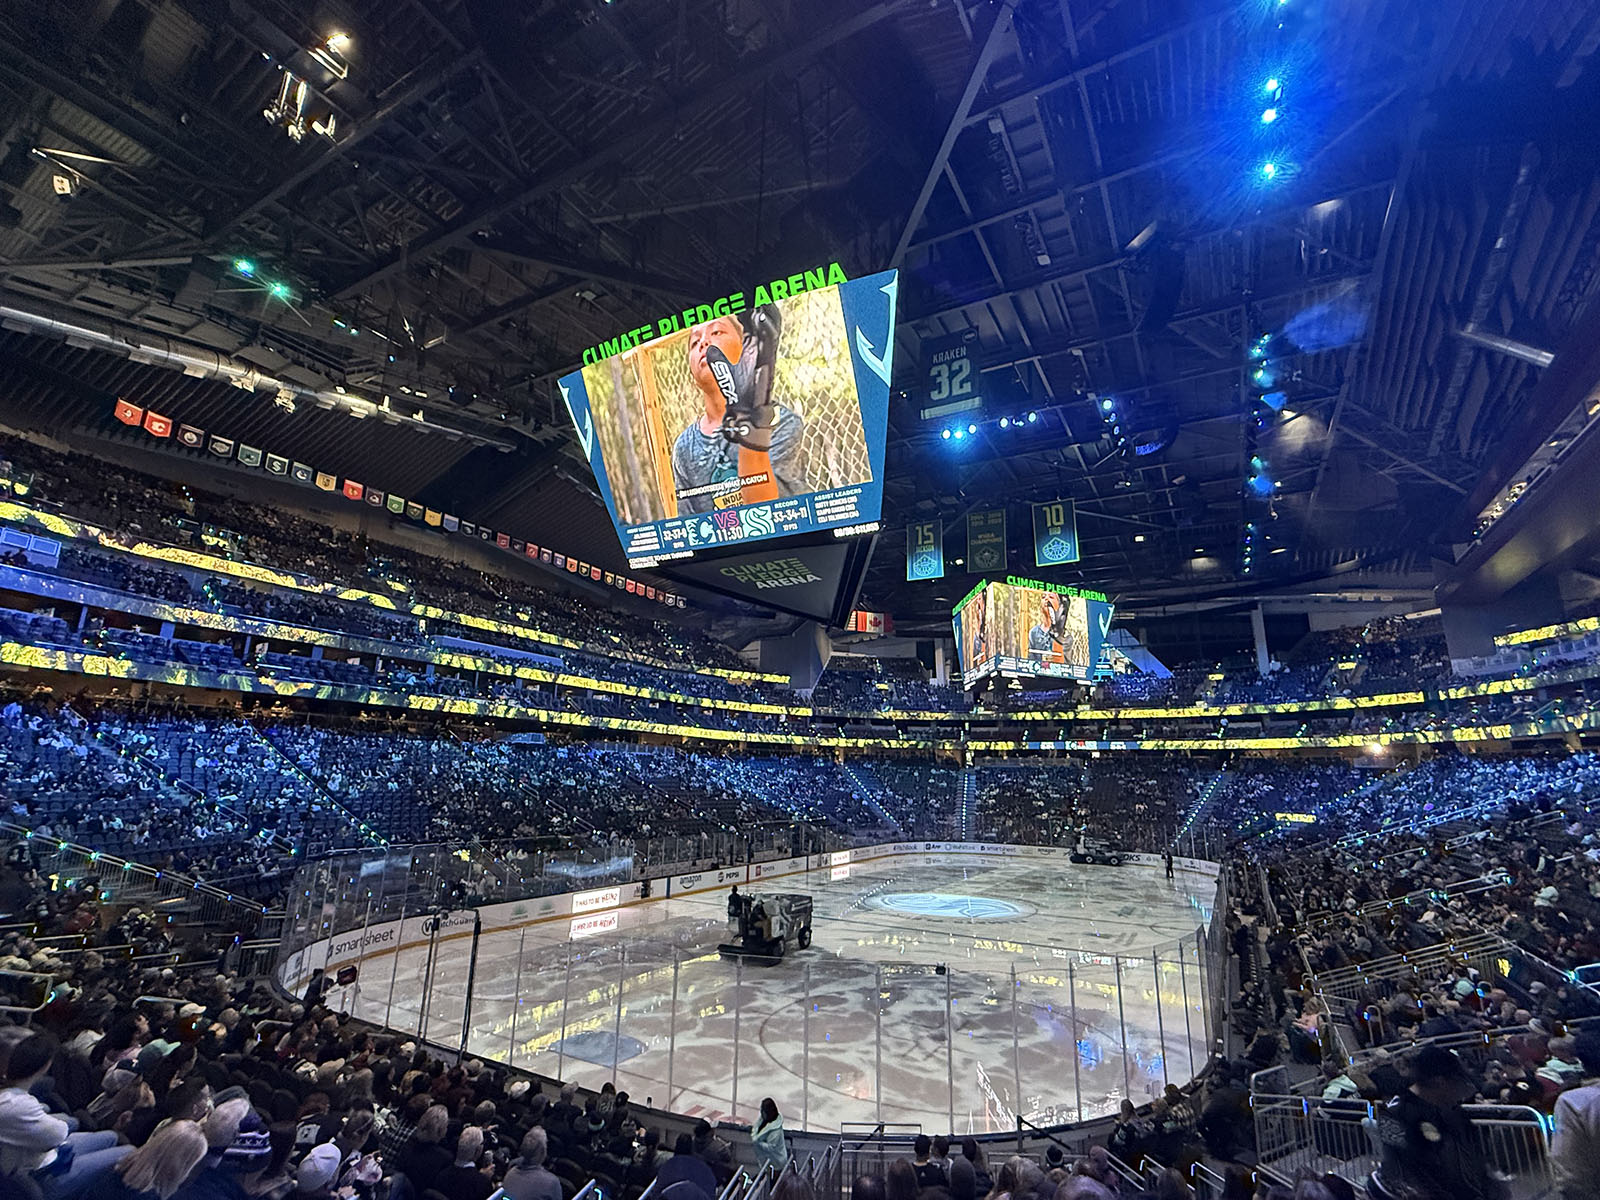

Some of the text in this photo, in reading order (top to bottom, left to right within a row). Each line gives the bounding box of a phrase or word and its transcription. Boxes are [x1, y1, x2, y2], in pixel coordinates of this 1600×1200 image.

[582, 262, 848, 367] CLIMATE PLEDGE ARENA
[932, 345, 967, 364] KRAKEN
[929, 358, 972, 400] 32
[774, 499, 798, 509] RECORD
[814, 488, 862, 502] ASSIST LEADERS
[714, 510, 740, 529] VS
[1042, 504, 1065, 527] 10
[716, 525, 743, 543] 11:30
[915, 524, 935, 545] 15
[720, 557, 803, 577] CLIMATE
[736, 566, 812, 583] PLEDGE
[755, 573, 823, 590] ARENA
[1007, 575, 1108, 603] CLIMATE PLEDGE ARENA
[679, 874, 702, 885] amazon
[726, 871, 740, 879] PEPSI
[335, 928, 394, 955] smartsheet
